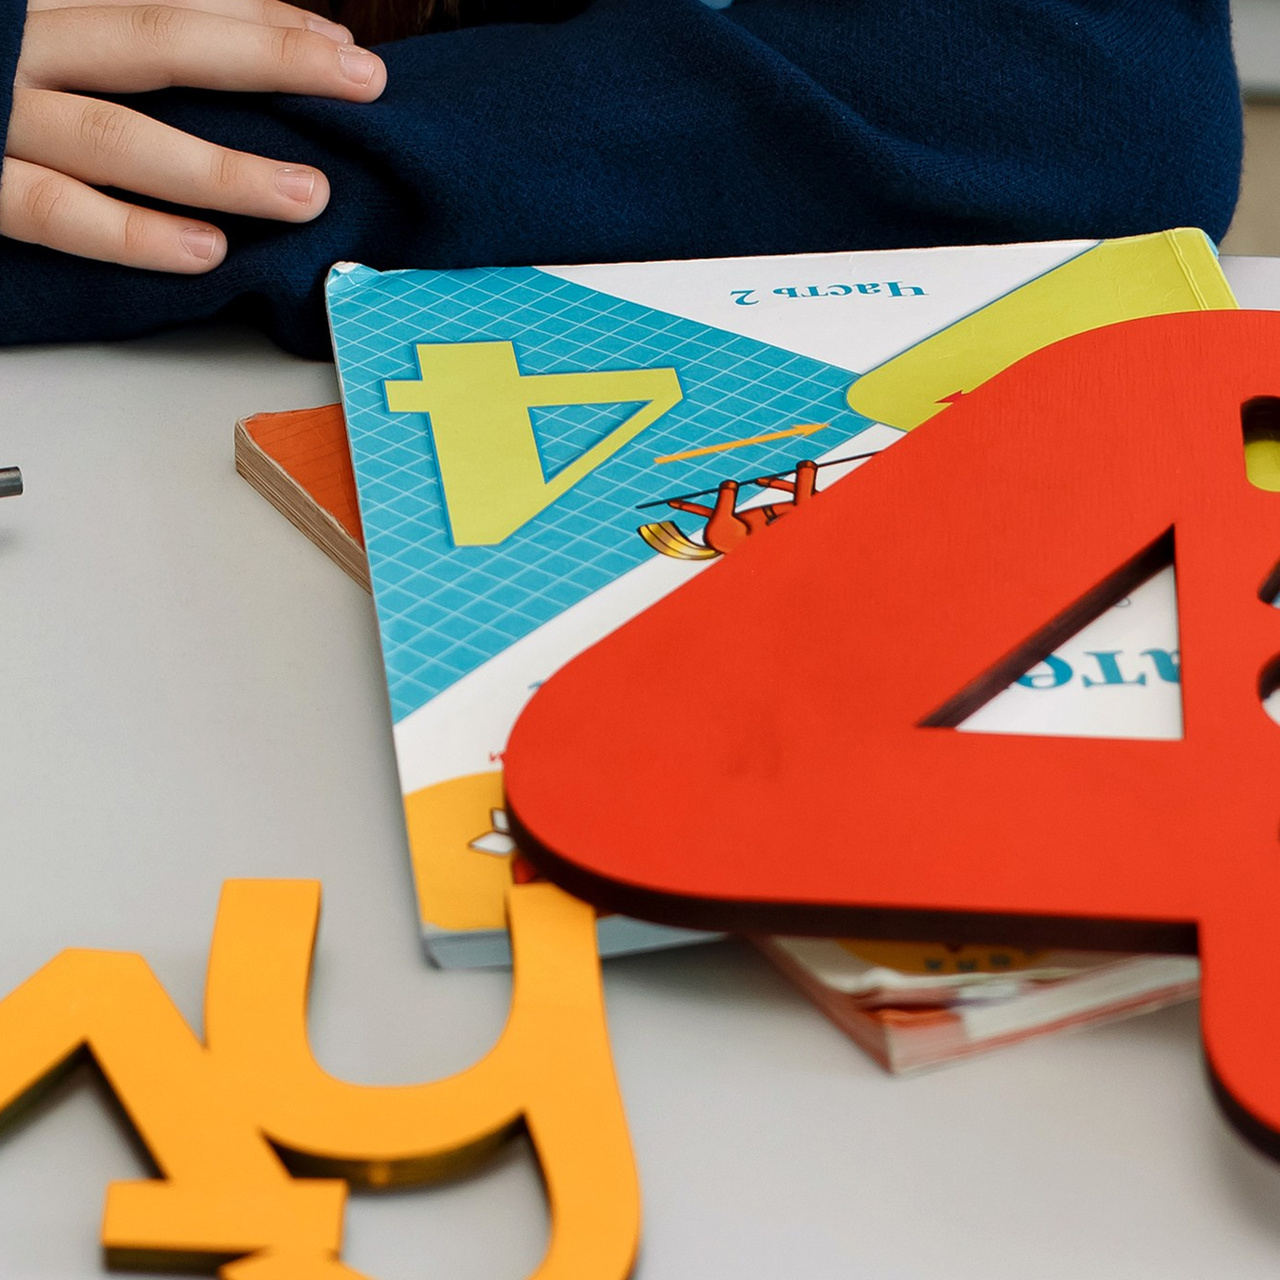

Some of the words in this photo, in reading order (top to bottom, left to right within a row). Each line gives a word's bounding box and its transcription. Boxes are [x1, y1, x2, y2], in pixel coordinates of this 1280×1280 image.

[729, 290, 760, 306] 2
[772, 280, 930, 298] Часть
[383, 340, 685, 547] 4
